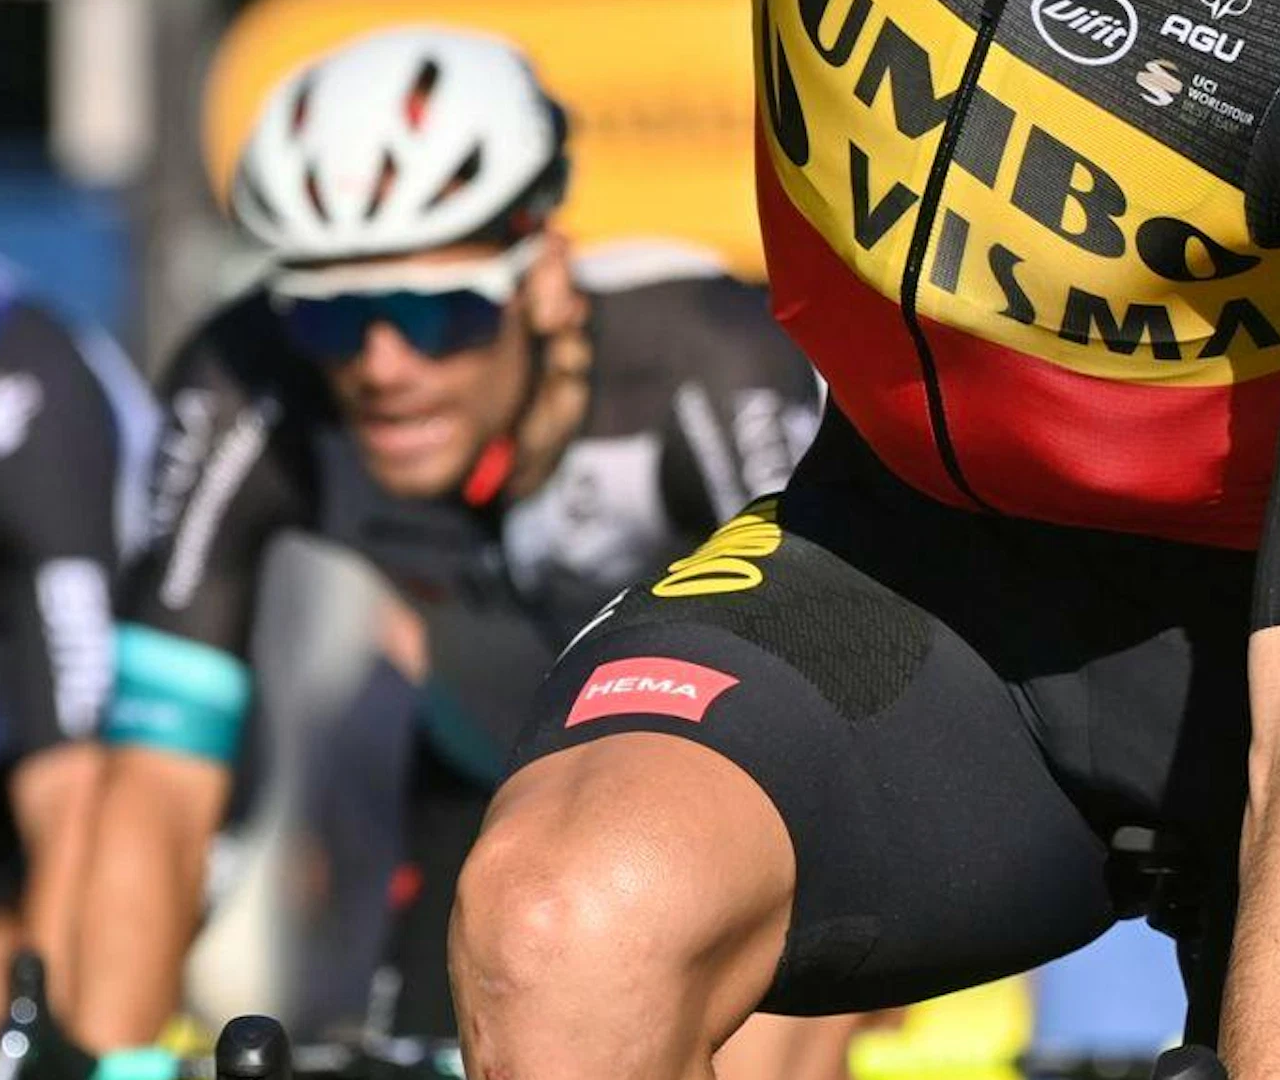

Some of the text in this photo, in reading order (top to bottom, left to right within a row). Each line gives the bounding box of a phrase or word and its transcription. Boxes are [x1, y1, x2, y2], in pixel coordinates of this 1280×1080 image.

[1159, 13, 1246, 64] AGU
[1191, 73, 1219, 94] UCI
[1187, 86, 1256, 125] WORLDTOUR
[583, 676, 699, 701] HEMA
